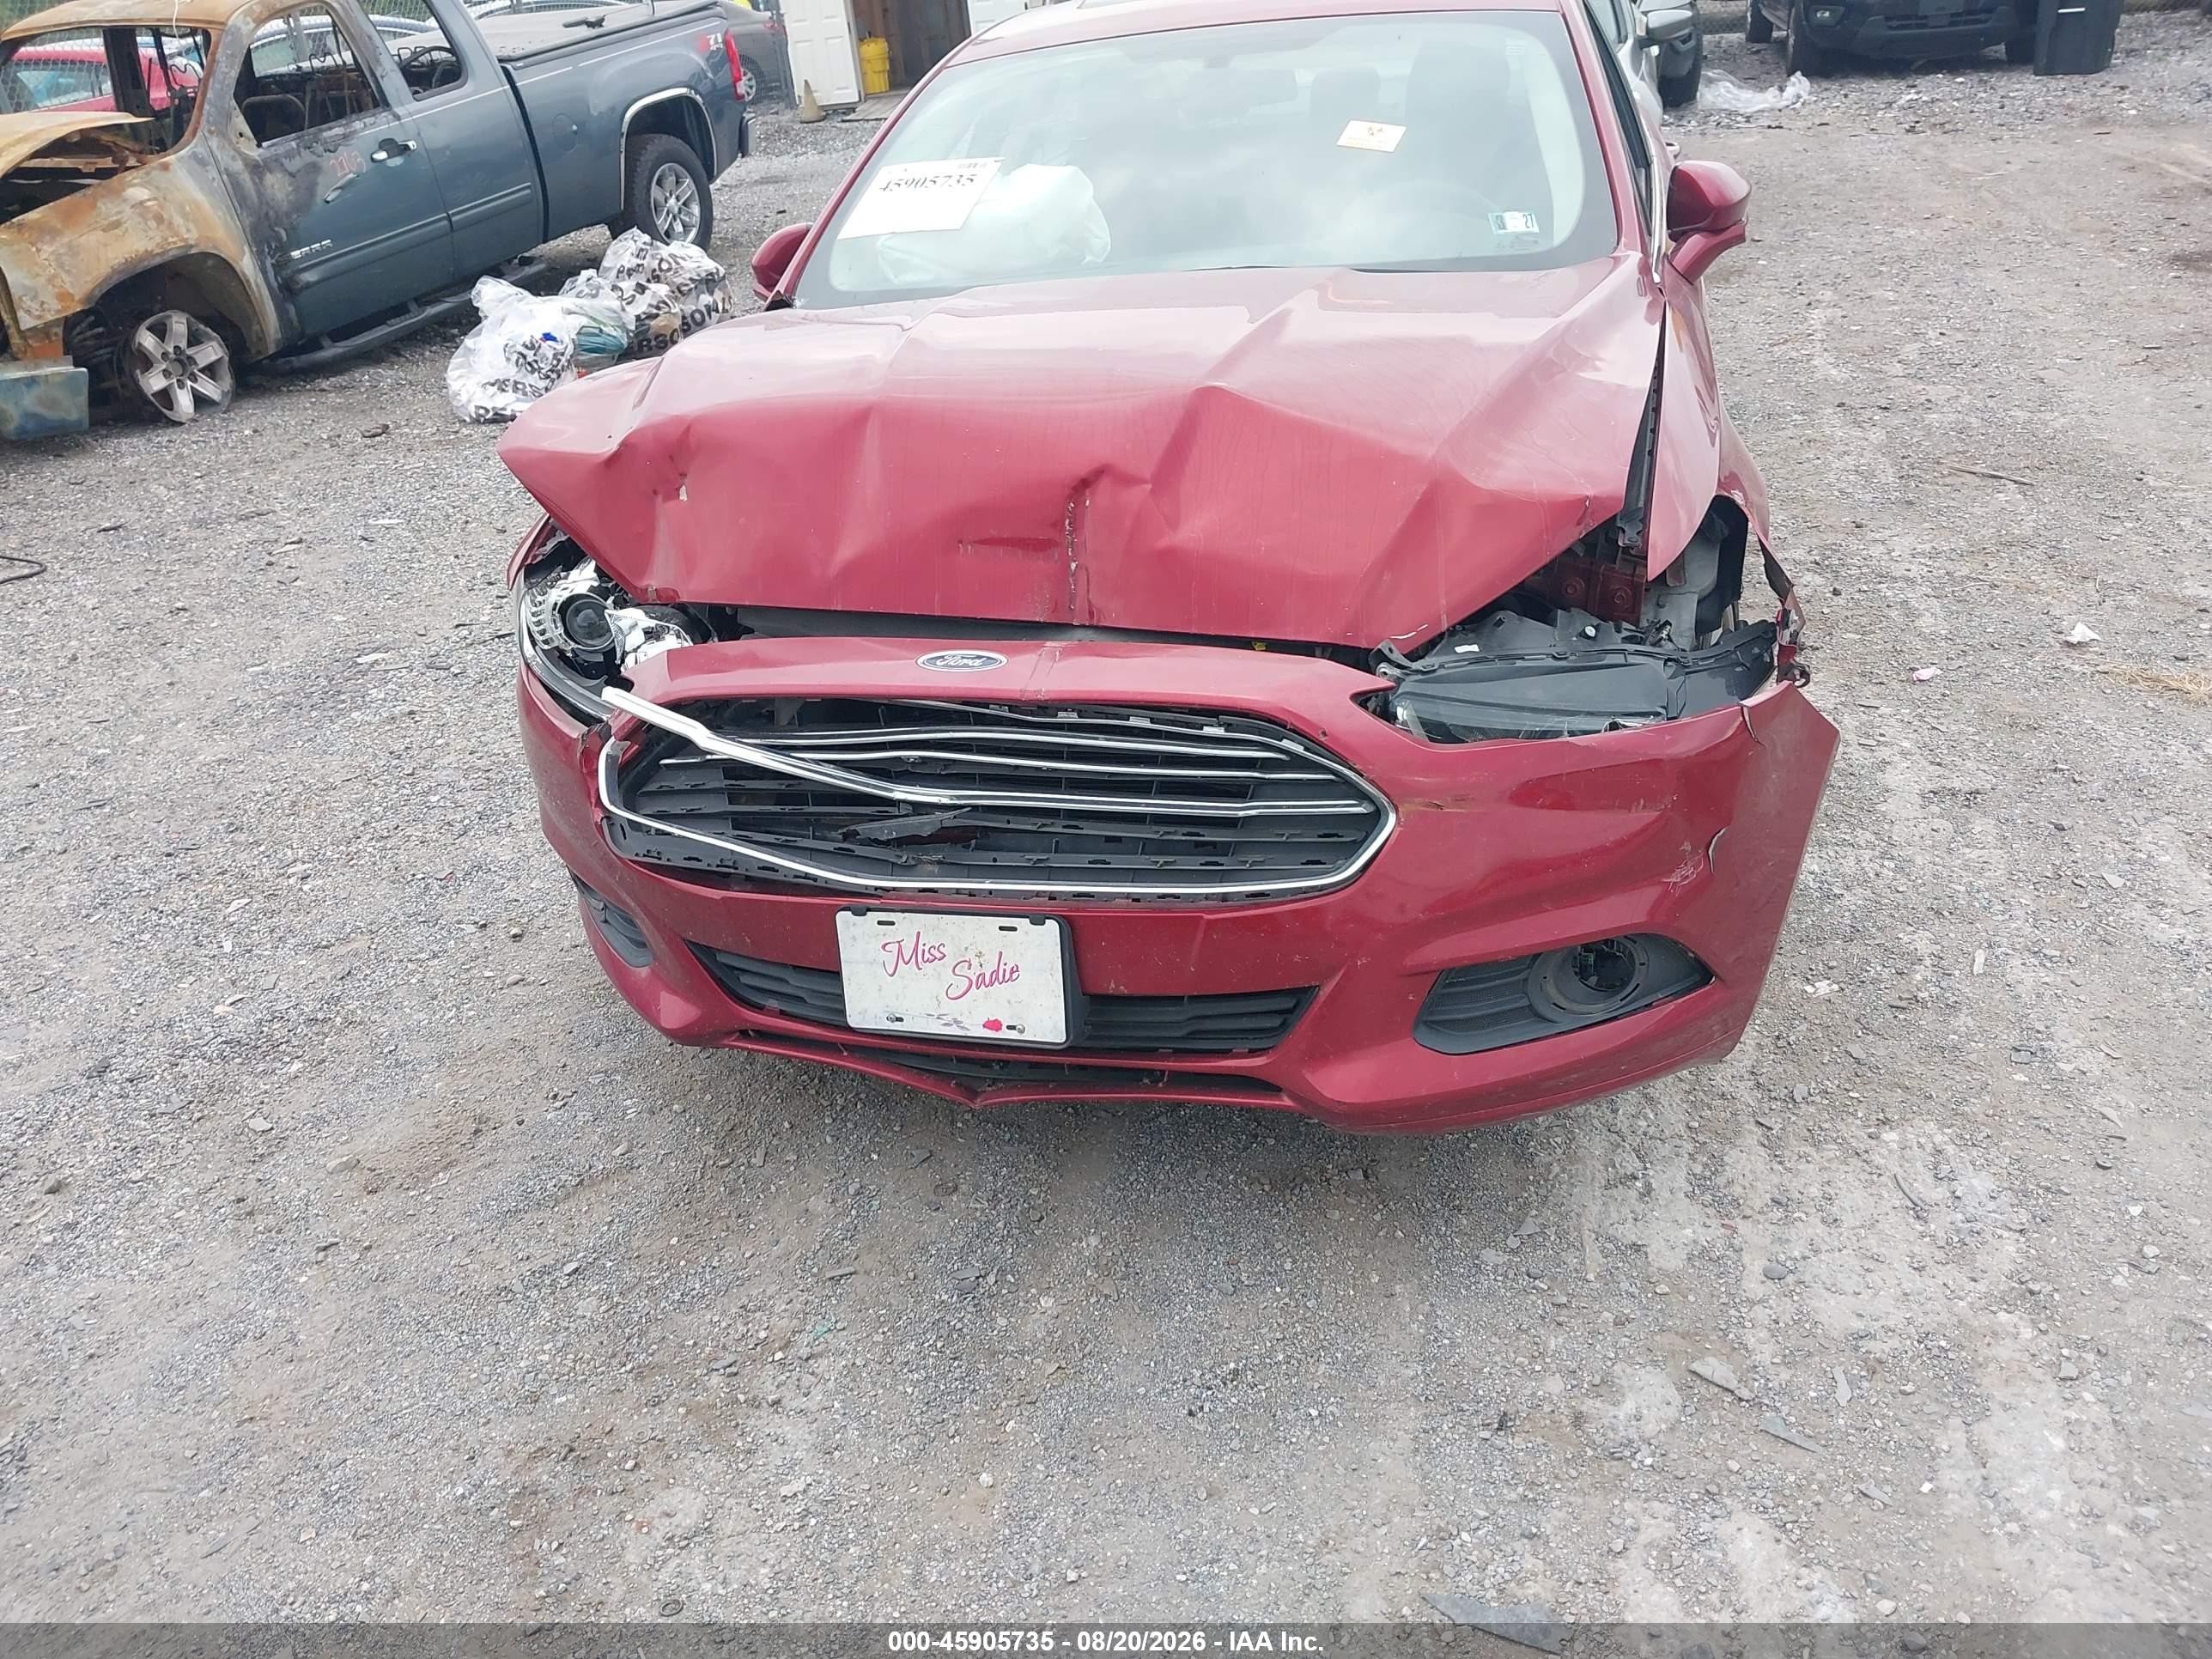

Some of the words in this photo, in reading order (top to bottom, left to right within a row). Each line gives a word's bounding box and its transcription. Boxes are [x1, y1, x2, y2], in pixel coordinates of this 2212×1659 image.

[878, 173, 978, 191] 45905735
[1522, 213, 1534, 228] 27
[935, 653, 988, 667] Ford
[881, 931, 946, 977] Miss
[945, 951, 1020, 1000] Sadie
